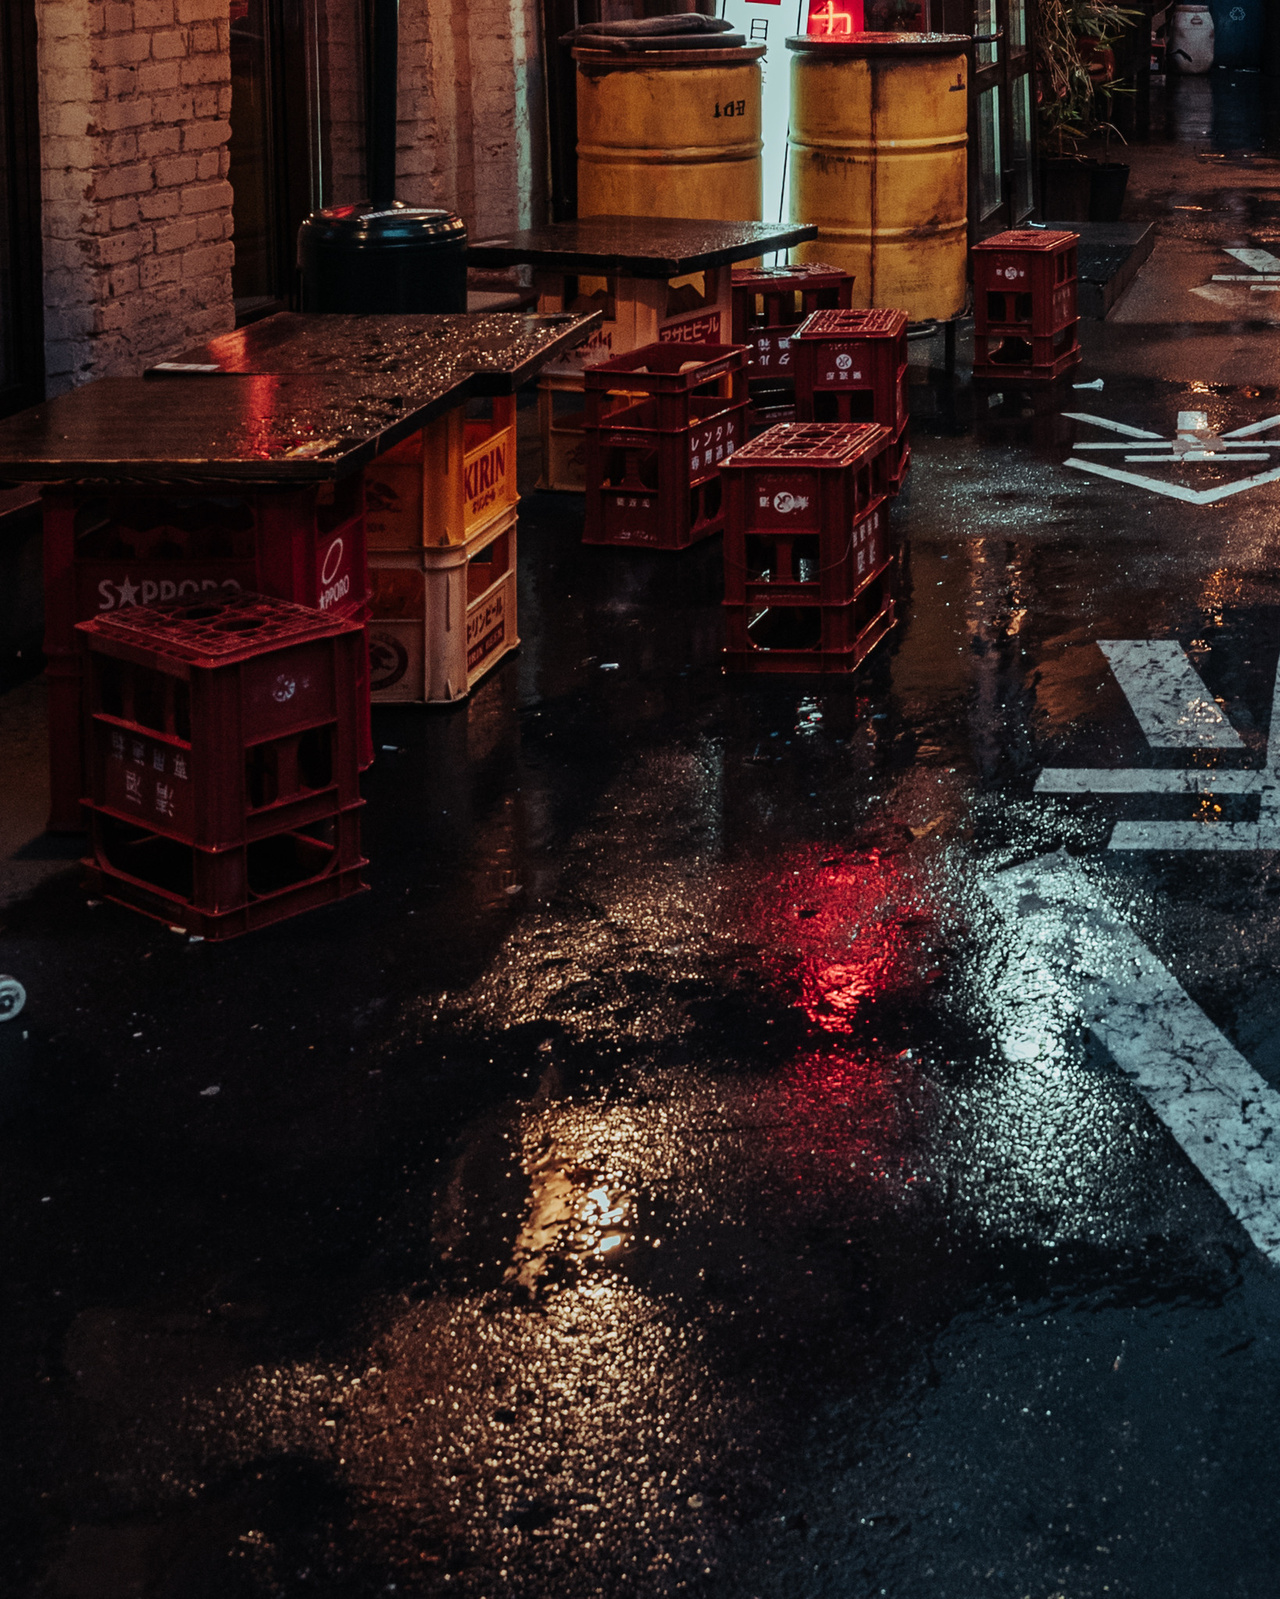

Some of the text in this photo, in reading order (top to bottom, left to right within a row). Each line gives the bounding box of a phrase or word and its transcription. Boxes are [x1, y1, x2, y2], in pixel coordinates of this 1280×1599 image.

[660, 315, 720, 343] アサヒビール
[690, 421, 735, 452] レンタル
[463, 441, 506, 504] KIRIN
[466, 595, 504, 644] キリンビール
